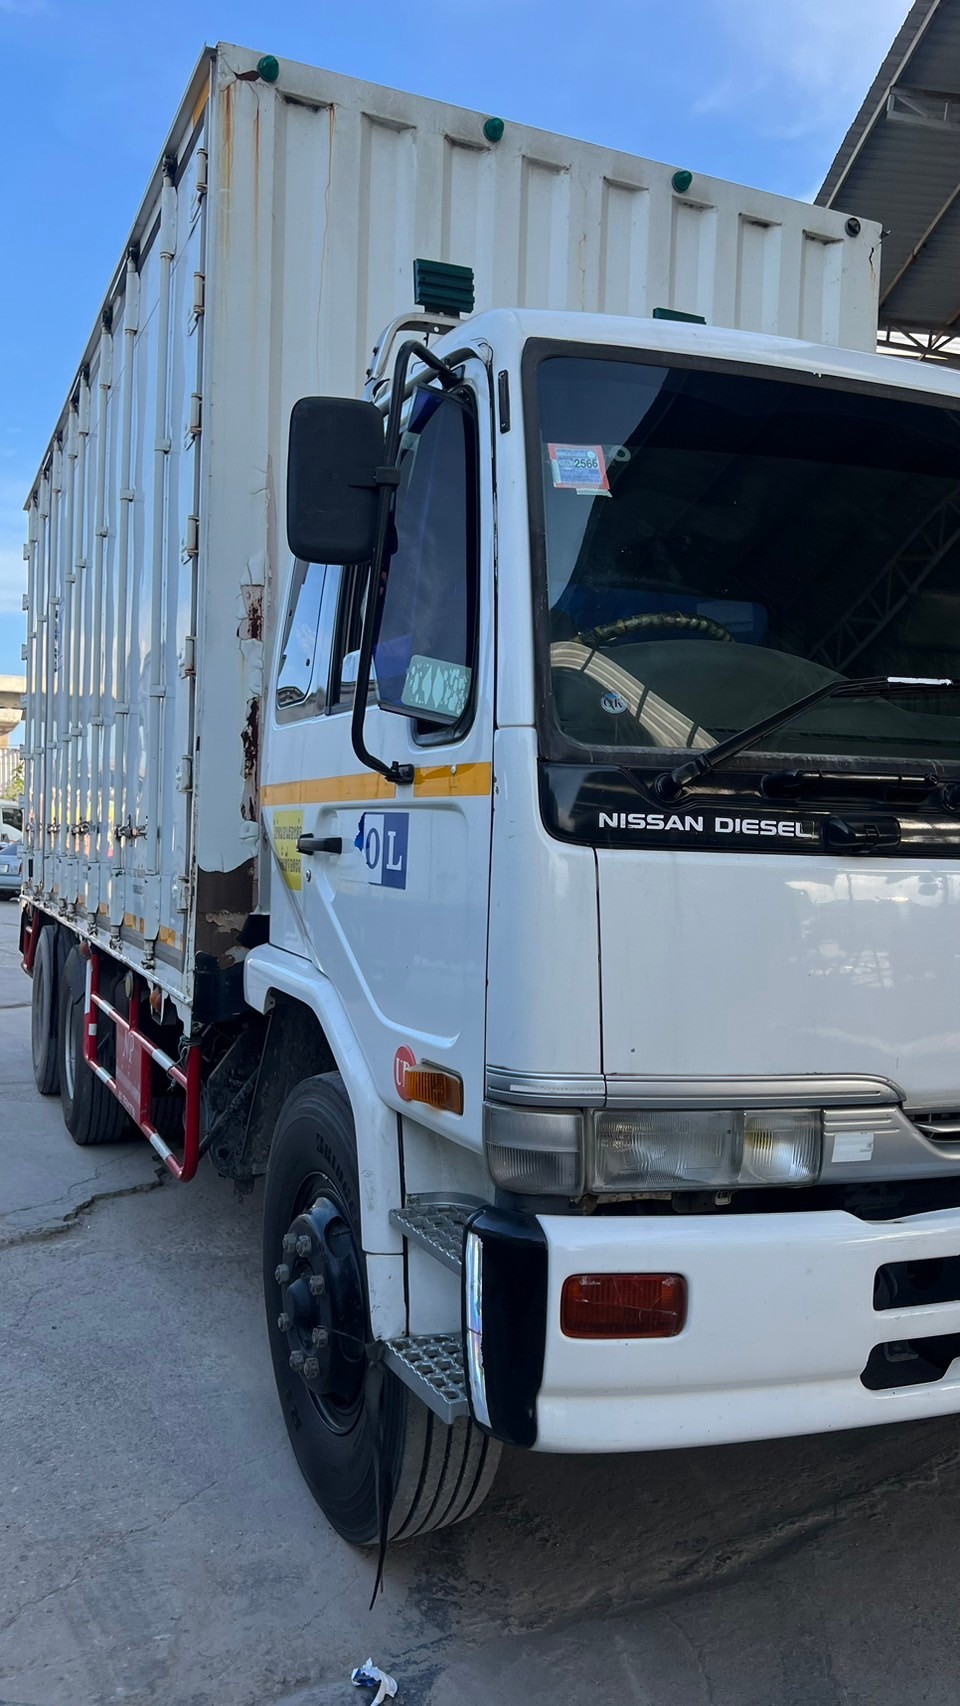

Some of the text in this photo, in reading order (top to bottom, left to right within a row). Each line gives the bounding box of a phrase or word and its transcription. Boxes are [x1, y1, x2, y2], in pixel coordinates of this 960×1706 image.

[573, 458, 599, 469] 2566
[599, 812, 819, 839] NISSAN DIESEL
